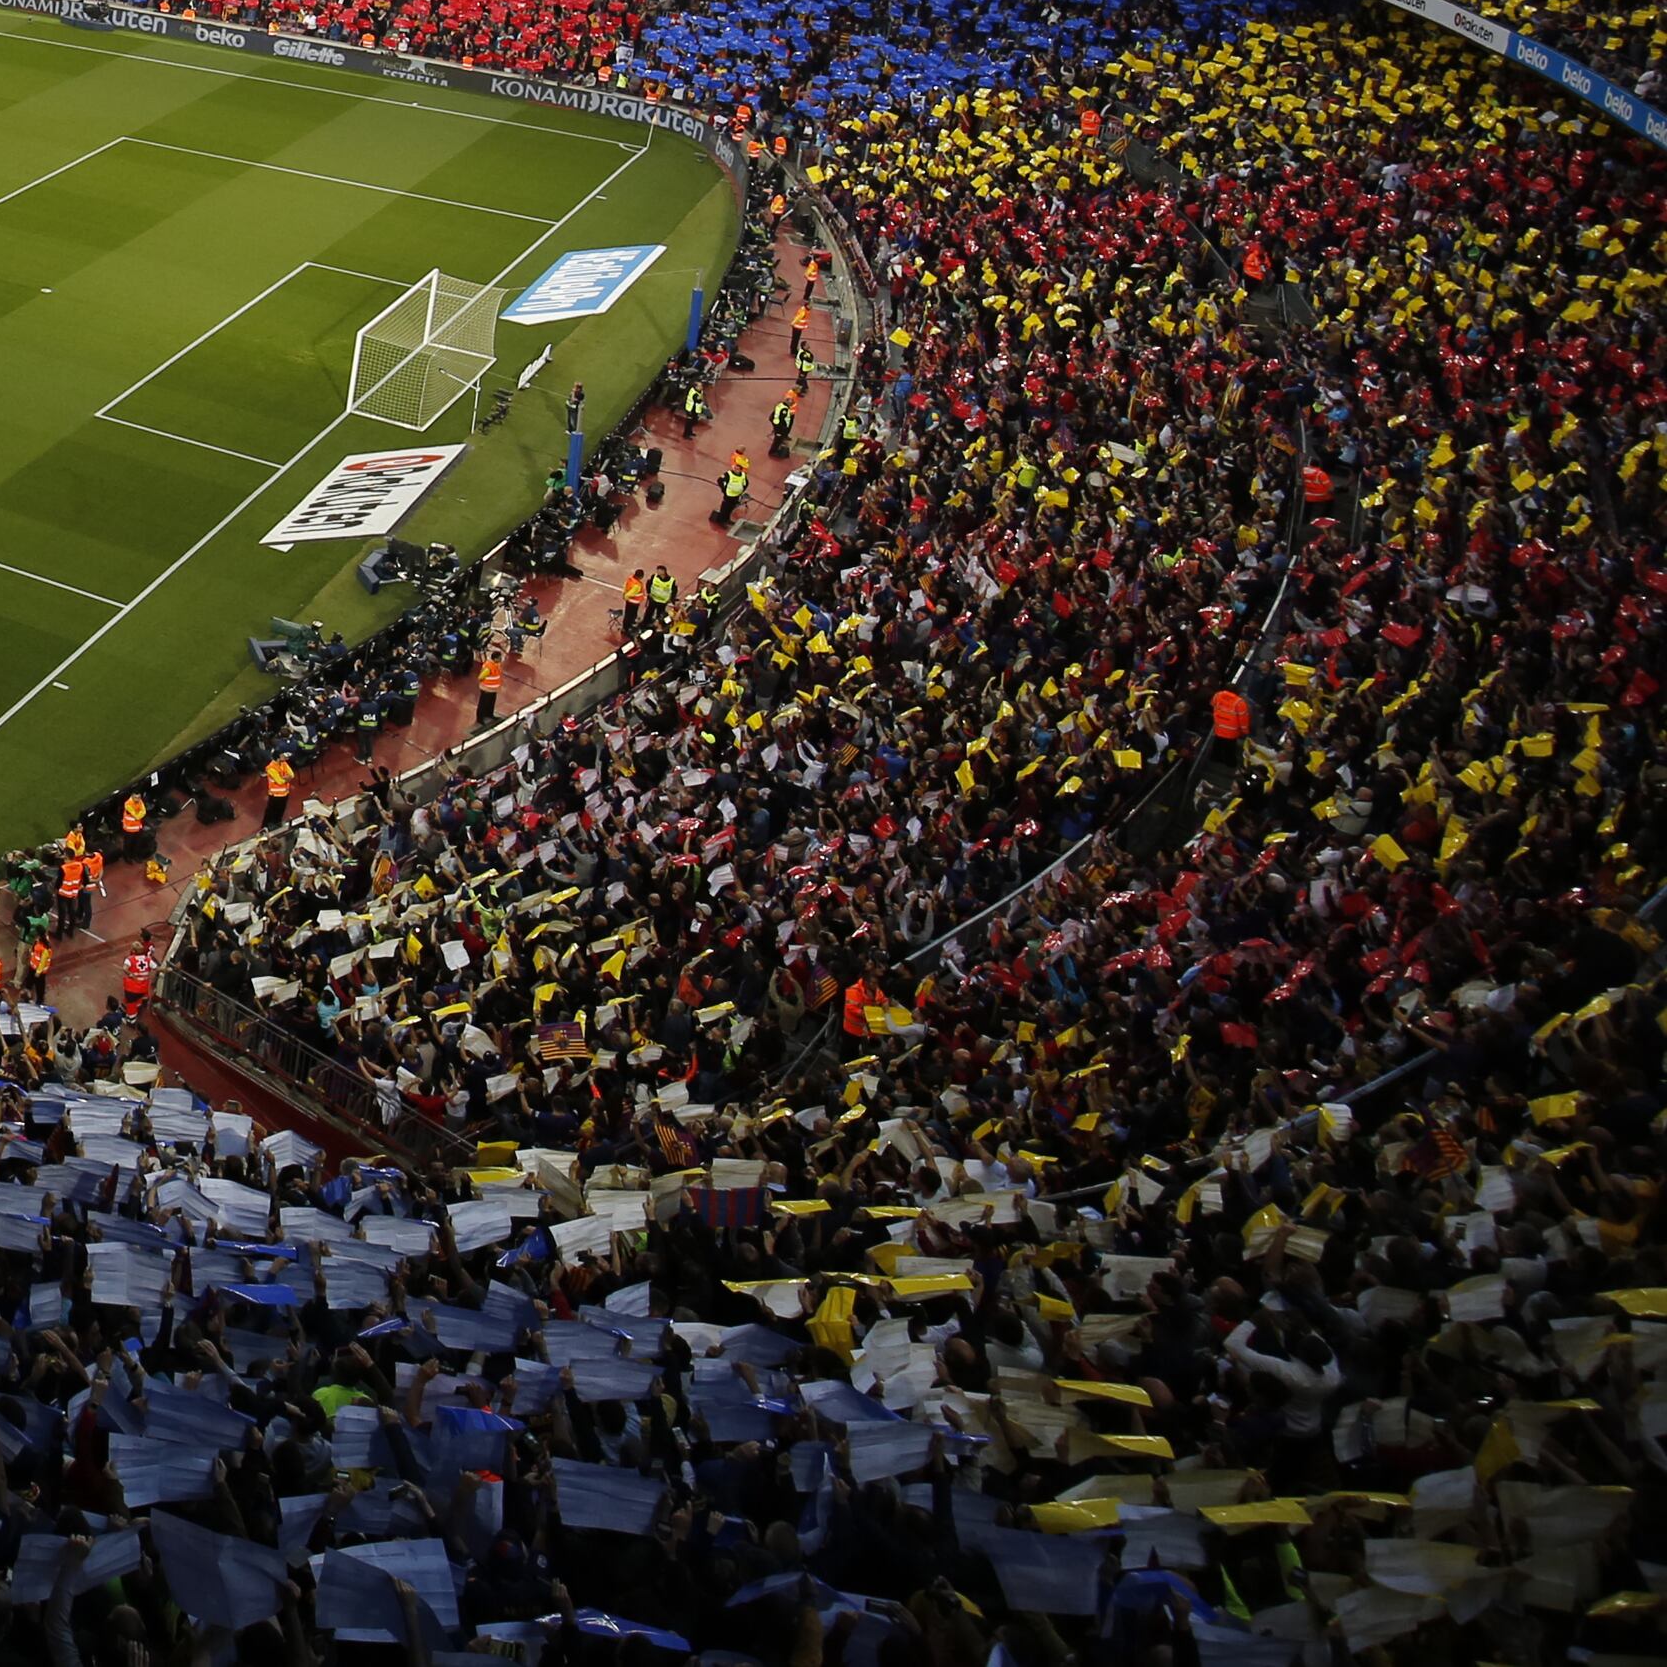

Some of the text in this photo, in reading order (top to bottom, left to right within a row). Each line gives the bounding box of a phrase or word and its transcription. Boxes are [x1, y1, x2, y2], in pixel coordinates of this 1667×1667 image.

[194, 21, 246, 48] beko
[1460, 17, 1495, 45] Rakuten
[272, 39, 347, 67] Gillette
[1516, 39, 1548, 71] beko
[491, 77, 587, 109] KONAMI
[1561, 62, 1592, 95] beko
[600, 95, 705, 142] Rakuten
[1603, 87, 1634, 121] beko
[715, 135, 735, 169] beko
[280, 465, 433, 535] Rakuten
